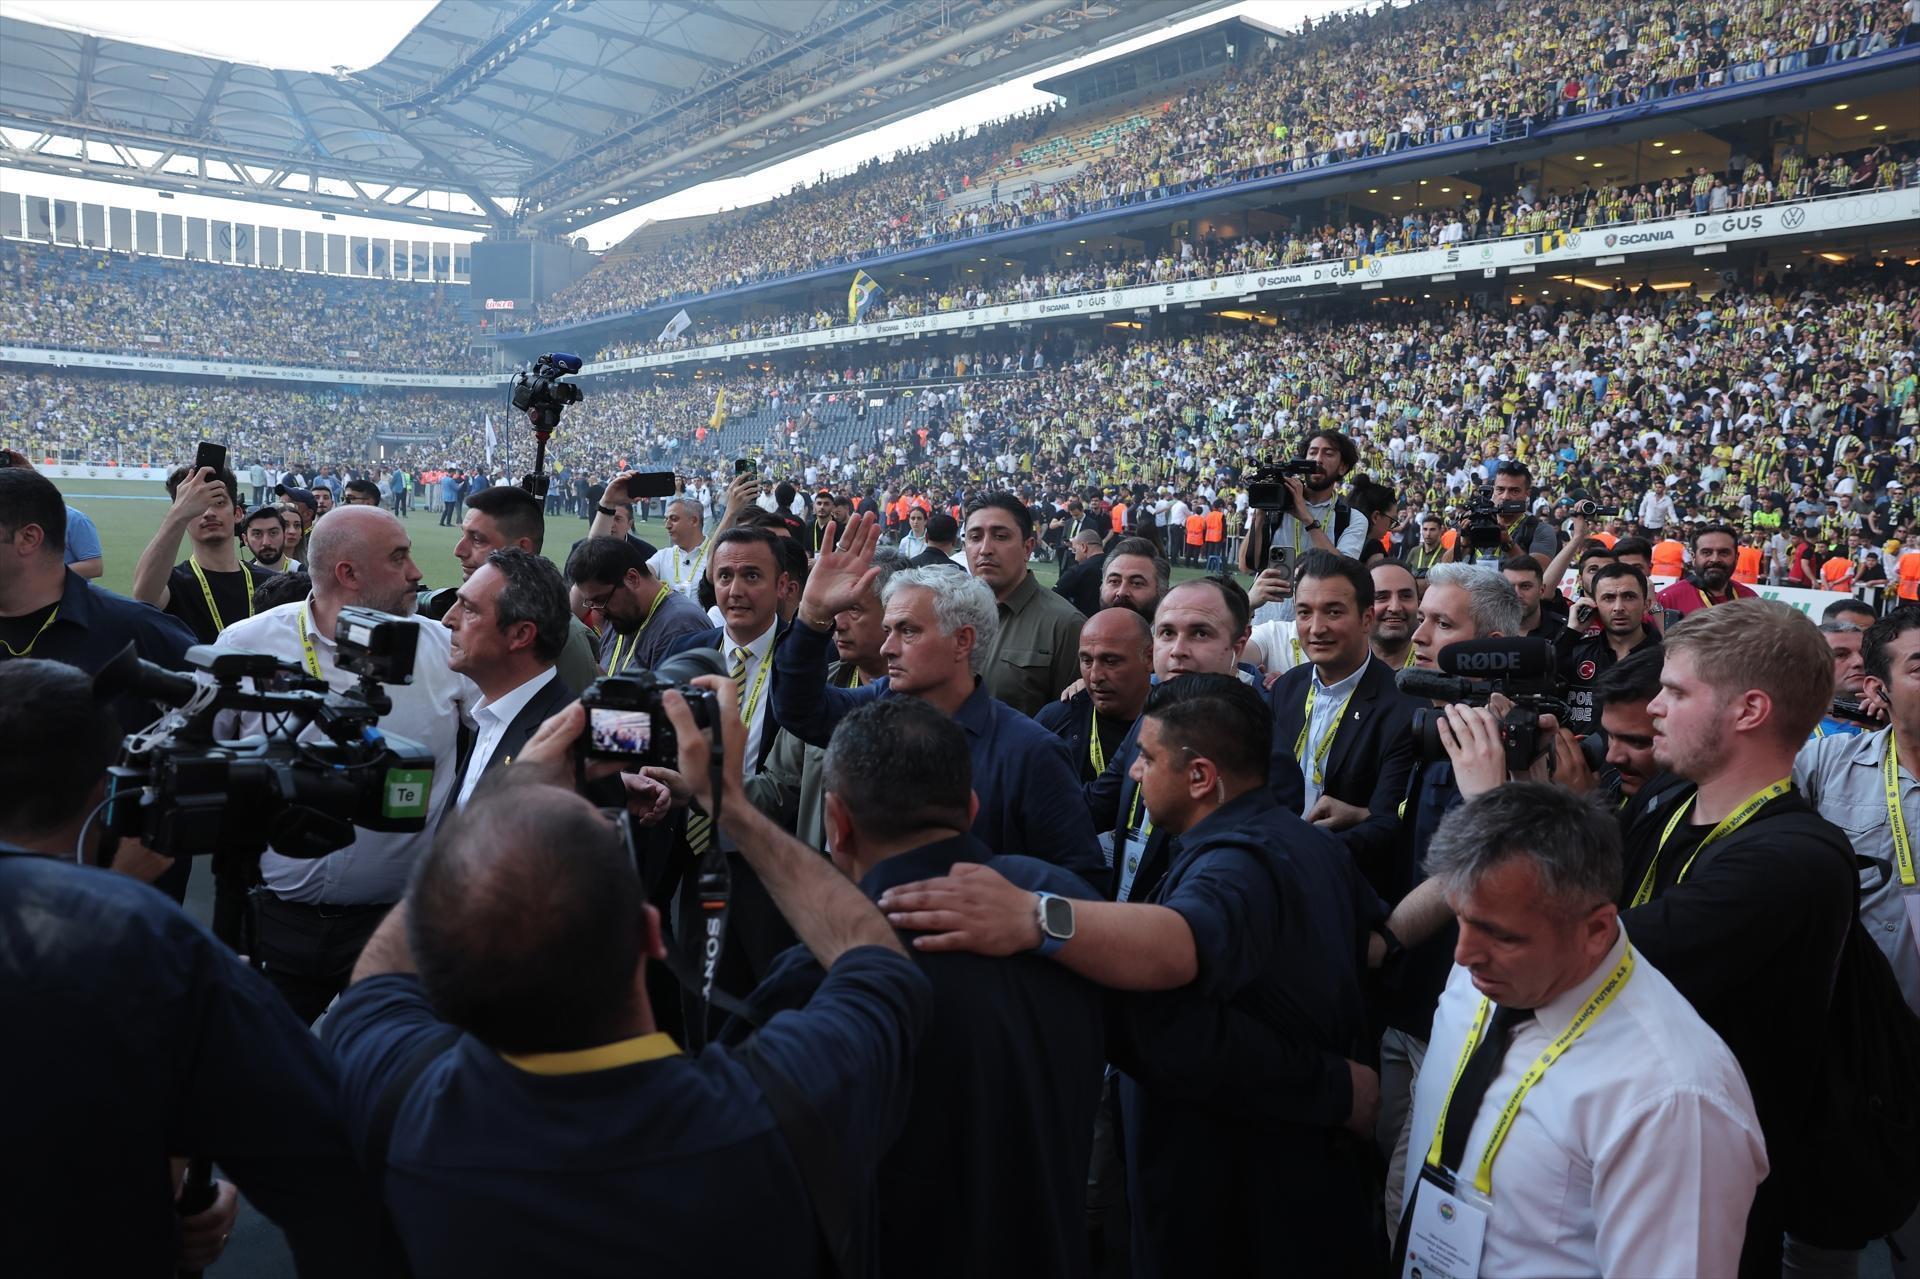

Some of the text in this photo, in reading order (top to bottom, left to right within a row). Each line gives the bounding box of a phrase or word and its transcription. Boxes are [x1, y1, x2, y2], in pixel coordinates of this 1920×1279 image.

[1619, 230, 1674, 246] SCANIA
[393, 253, 470, 273] SCANI
[1267, 275, 1302, 286] SCANIA
[1456, 652, 1520, 670] RØDE
[1567, 691, 1593, 706] POR
[398, 788, 415, 802] Te
[1556, 1002, 1596, 1048] FENERBAHÇE
[1594, 979, 1618, 1005] FUTBOL
